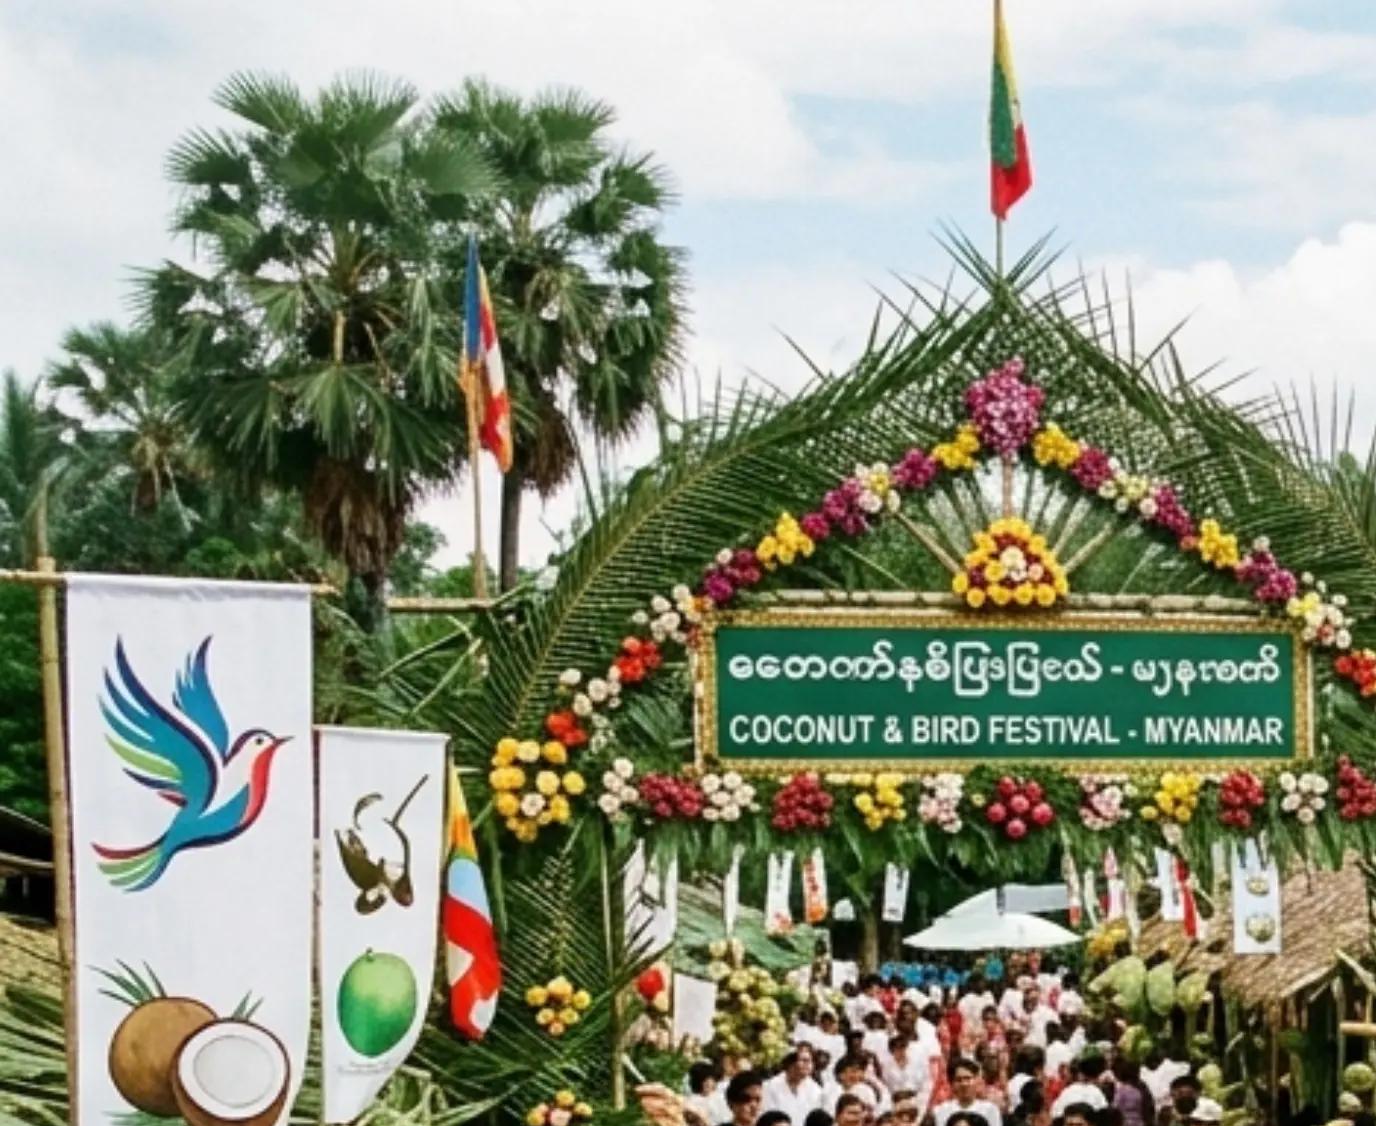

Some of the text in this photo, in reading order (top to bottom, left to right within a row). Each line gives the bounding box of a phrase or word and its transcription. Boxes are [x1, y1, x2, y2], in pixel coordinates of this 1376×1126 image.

[729, 714, 875, 744] COCONUT
[883, 715, 904, 744] &
[912, 715, 980, 744] BIRD
[989, 715, 1120, 745] FESTIVAL
[1145, 716, 1284, 745] MYANMAR
